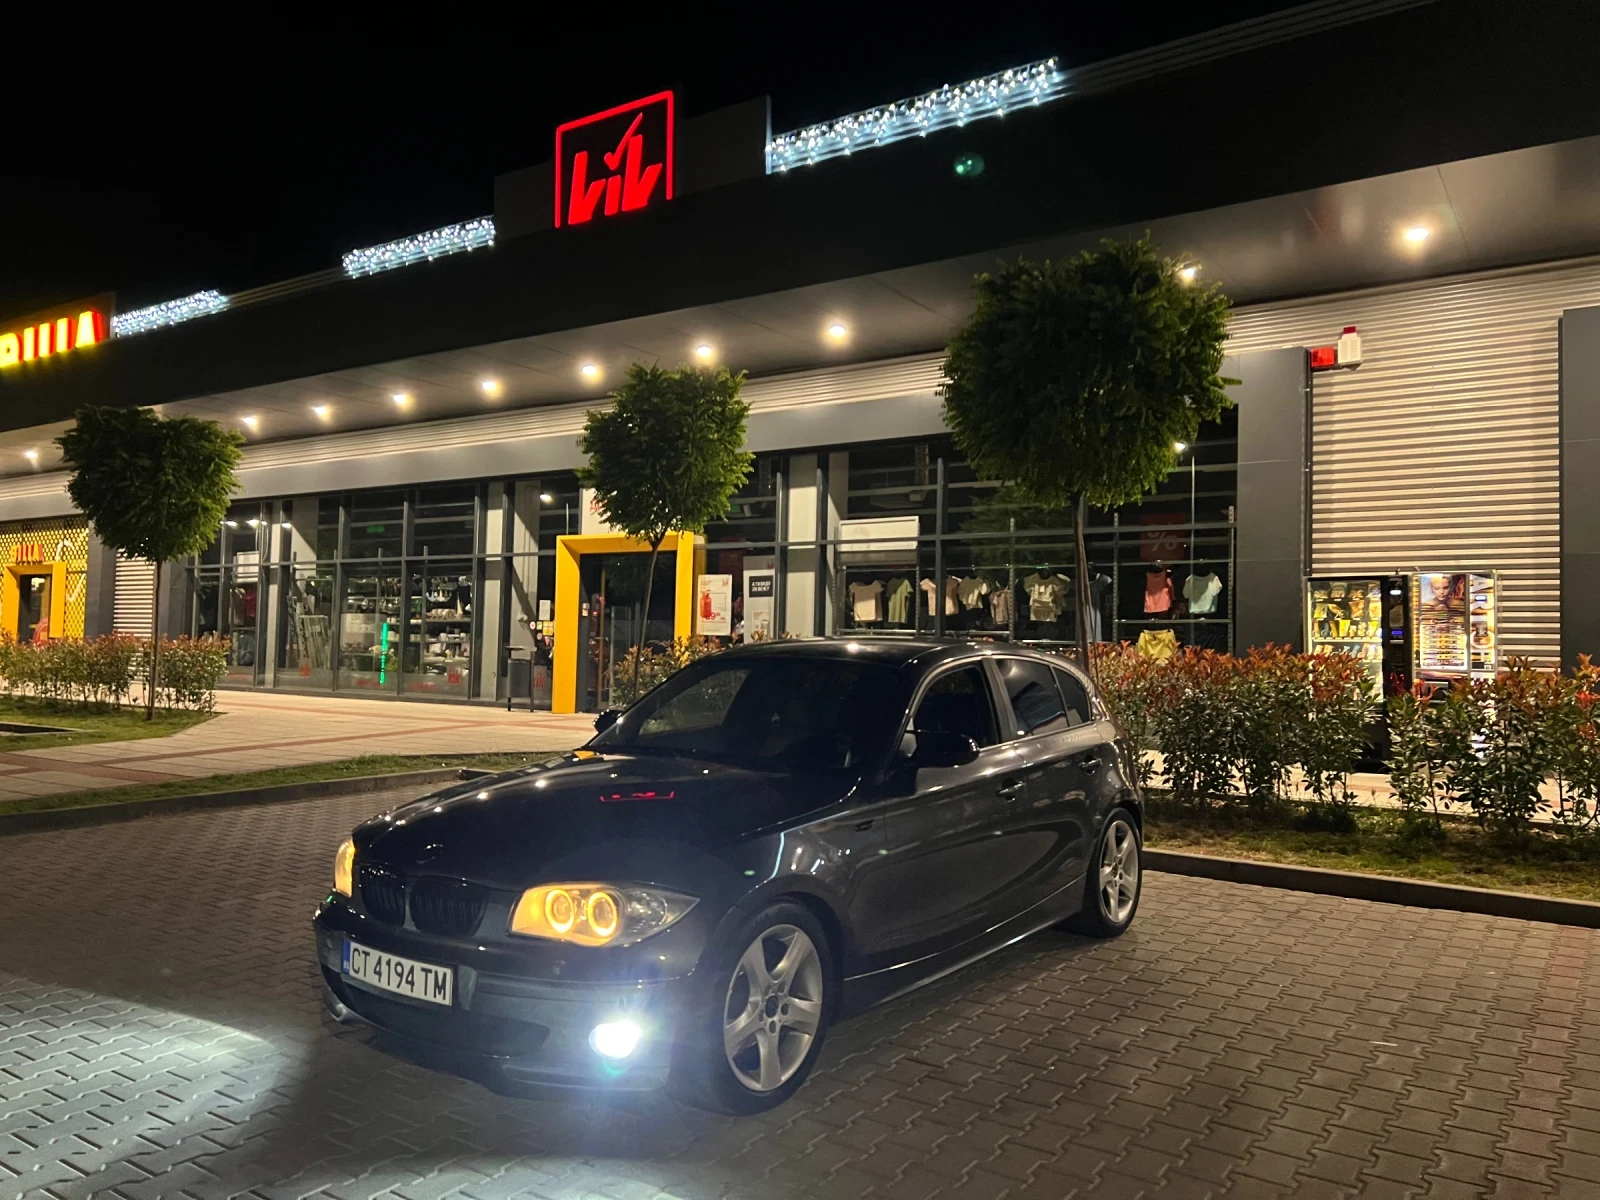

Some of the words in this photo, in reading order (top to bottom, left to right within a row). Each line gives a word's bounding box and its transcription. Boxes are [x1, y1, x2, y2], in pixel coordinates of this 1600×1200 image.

[8, 543, 43, 562] BILLA
[352, 947, 371, 978] CT
[373, 955, 416, 993] 4194
[421, 967, 448, 1001] TM
